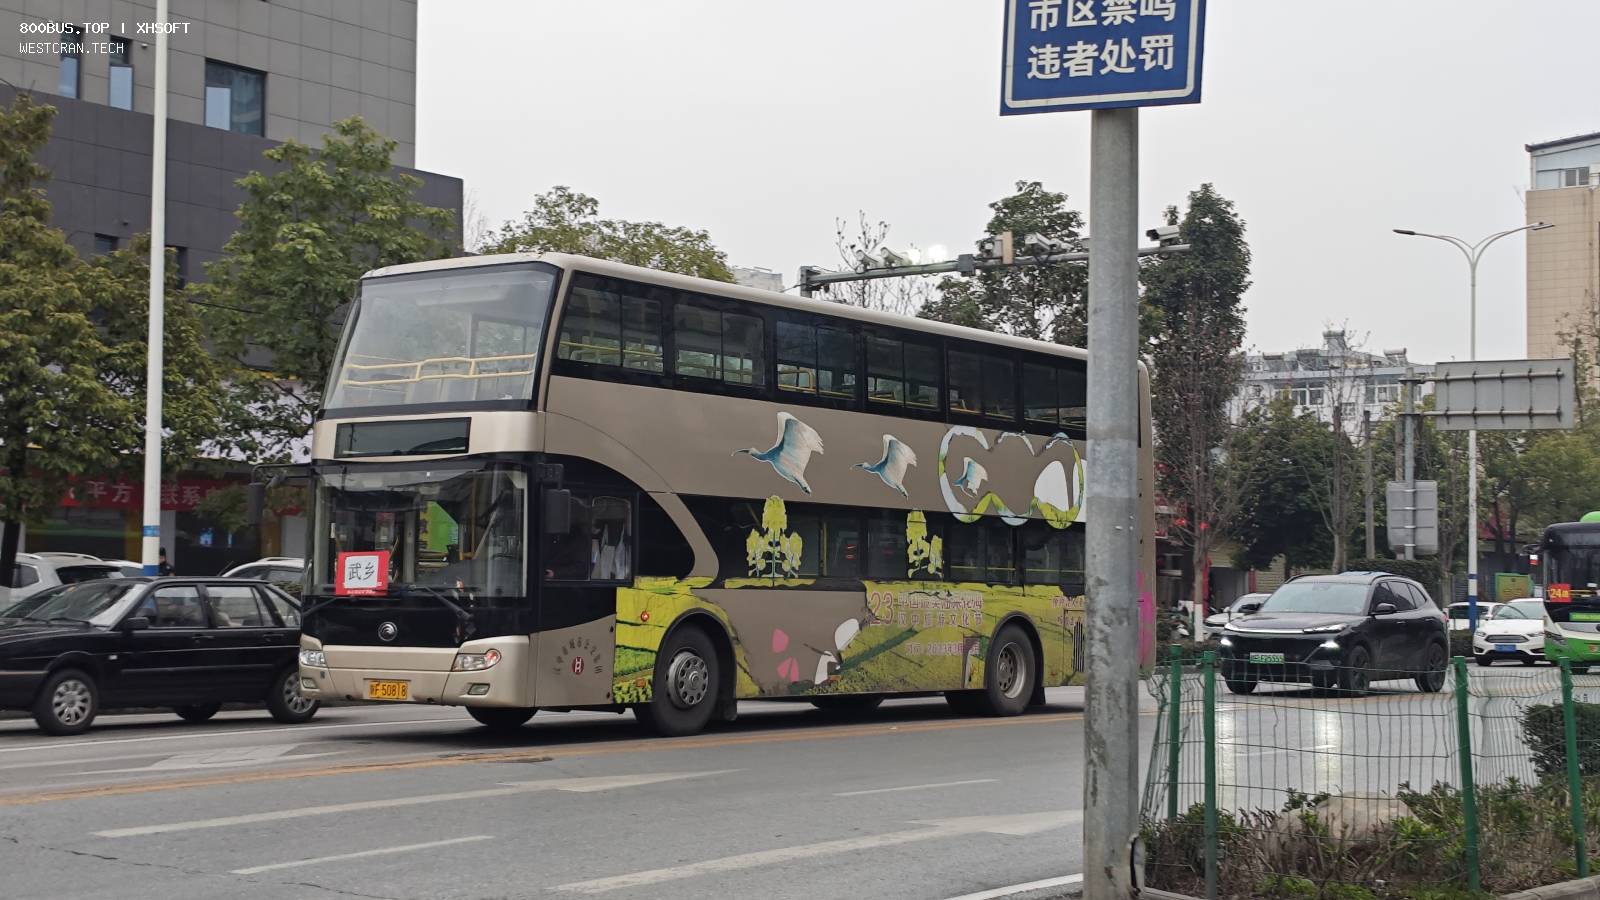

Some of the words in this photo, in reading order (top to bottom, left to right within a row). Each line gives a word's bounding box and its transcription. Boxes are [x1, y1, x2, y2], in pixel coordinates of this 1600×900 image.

[1029, 0, 1176, 32] 市区禁鸣
[1027, 34, 1174, 80] 违者处罚
[348, 561, 375, 580] 武乡
